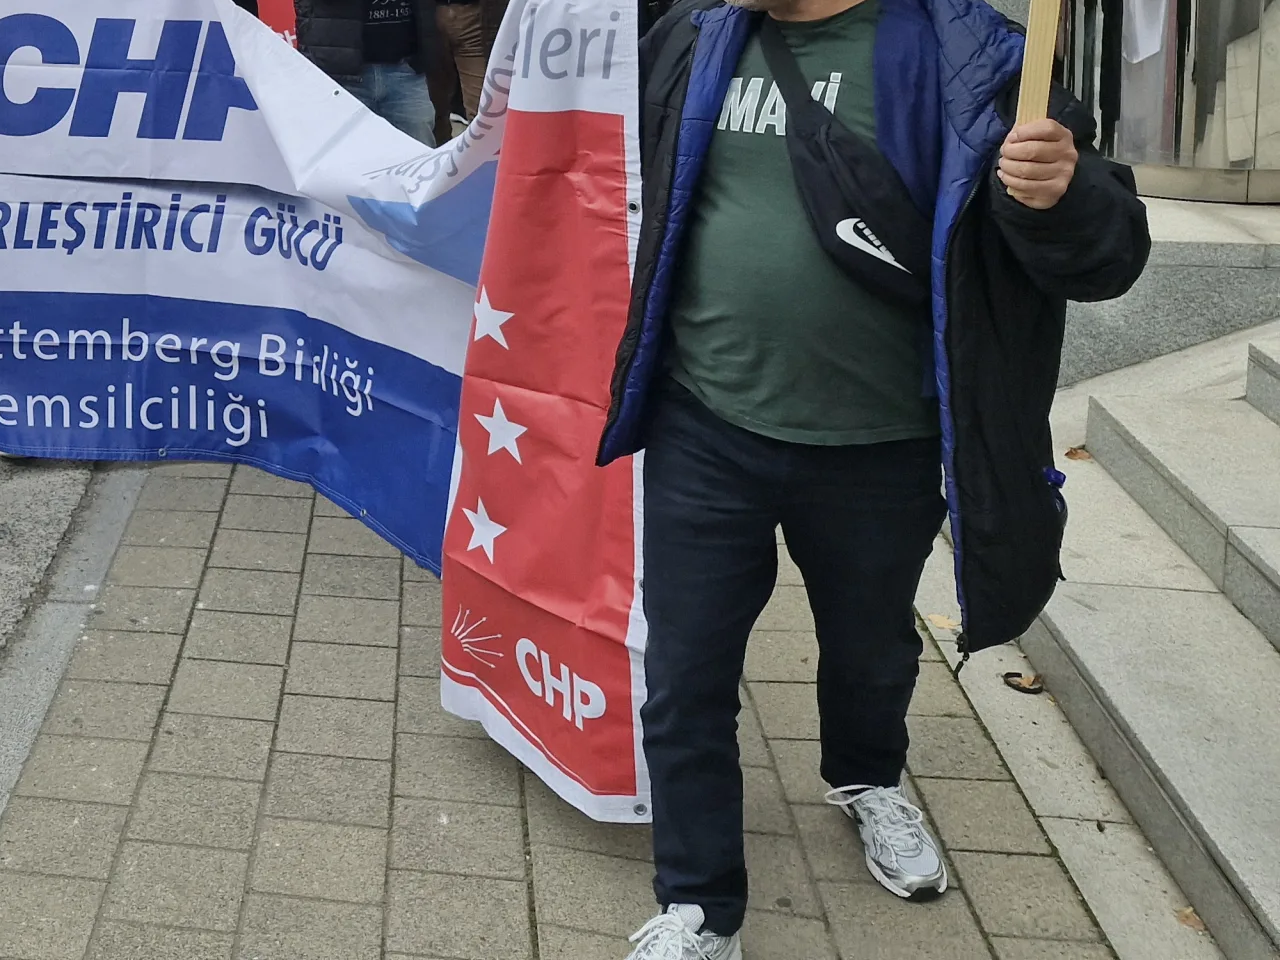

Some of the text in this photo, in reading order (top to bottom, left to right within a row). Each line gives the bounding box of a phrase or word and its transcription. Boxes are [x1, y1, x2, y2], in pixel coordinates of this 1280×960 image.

[521, 7, 621, 81] leri
[243, 202, 344, 272] GÜCÜ
[258, 333, 375, 417] Birliği
[515, 637, 607, 731] CHP
